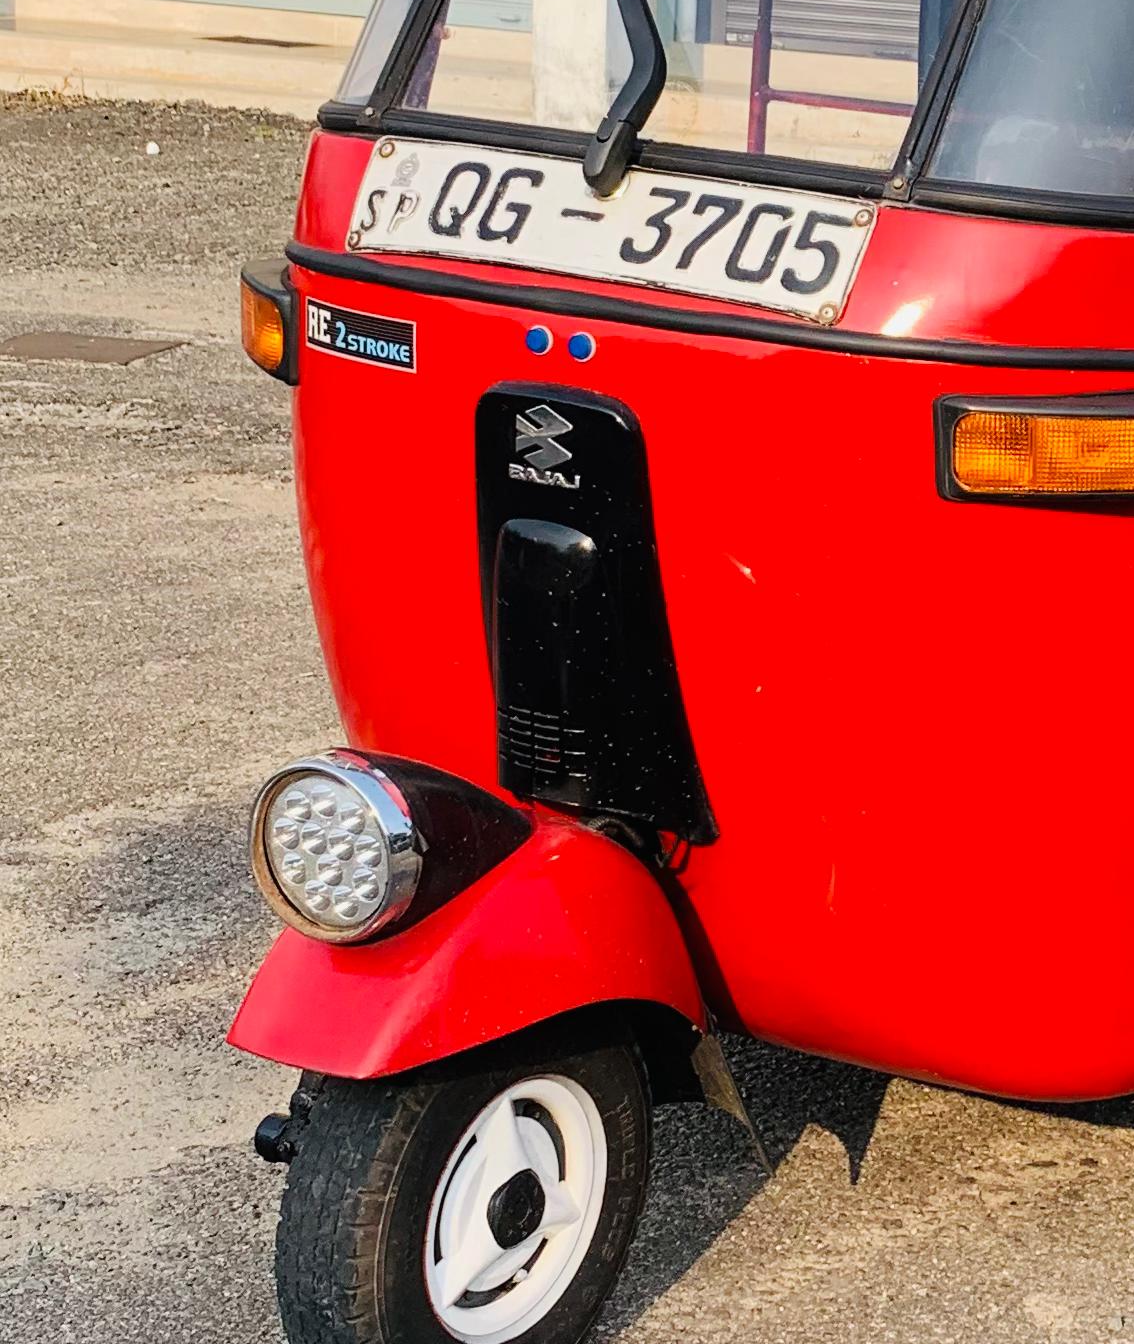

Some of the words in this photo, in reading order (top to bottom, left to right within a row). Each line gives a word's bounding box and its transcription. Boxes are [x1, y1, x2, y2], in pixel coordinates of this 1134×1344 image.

[361, 189, 421, 234] SP
[428, 161, 544, 245] QG
[561, 206, 606, 222] -
[619, 187, 856, 295] 3705
[308, 304, 331, 344] RE
[335, 321, 346, 349] 2
[348, 334, 410, 363] STROKE
[509, 463, 580, 488] BAJAJ
